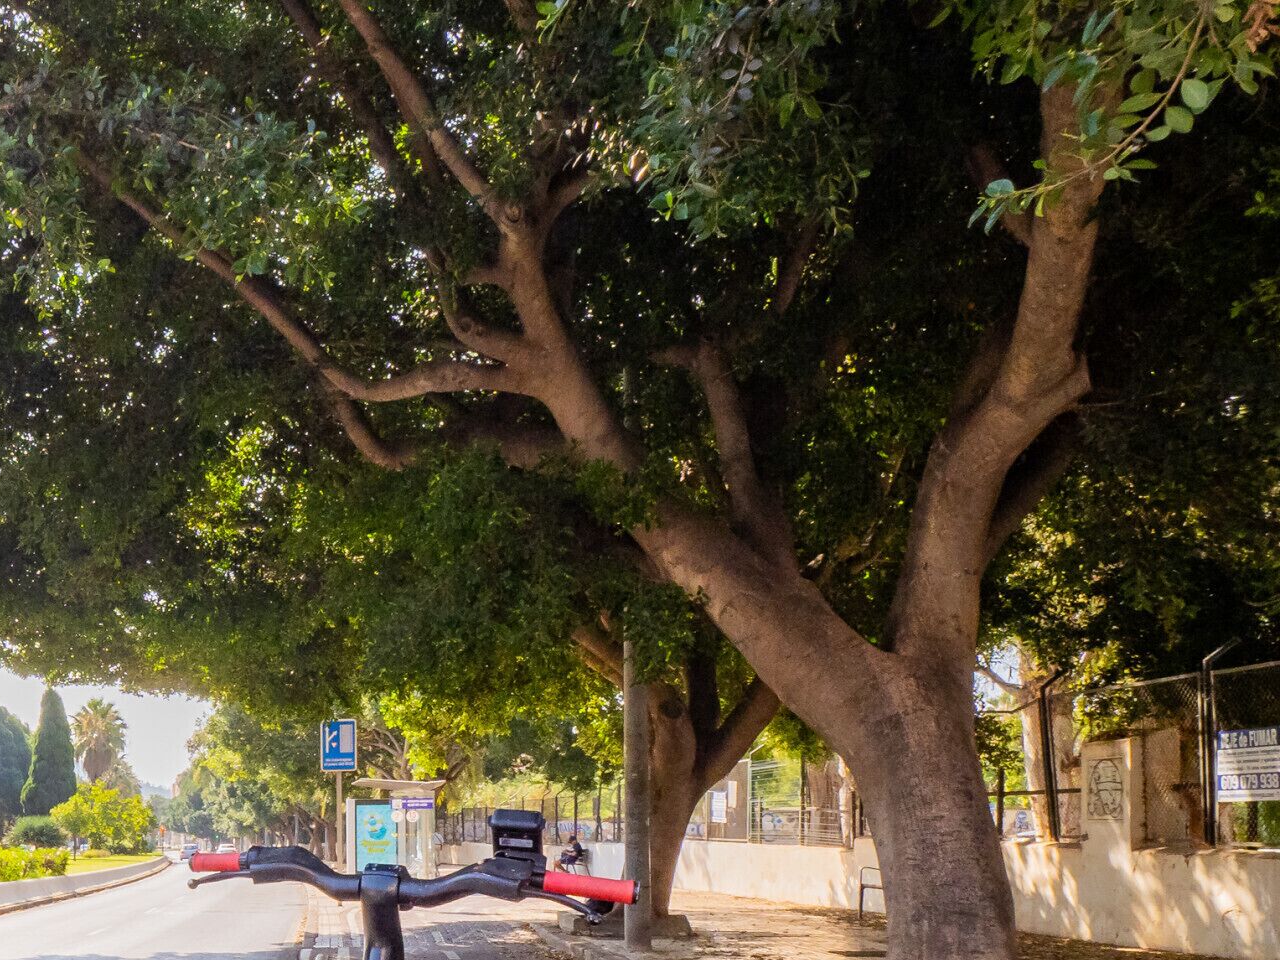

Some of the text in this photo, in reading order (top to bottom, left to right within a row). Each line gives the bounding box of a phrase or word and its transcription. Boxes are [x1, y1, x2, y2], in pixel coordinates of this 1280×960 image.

[1249, 728, 1278, 746] FUMAR
[1221, 775, 1239, 790] 609
[1260, 773, 1279, 789] 938
